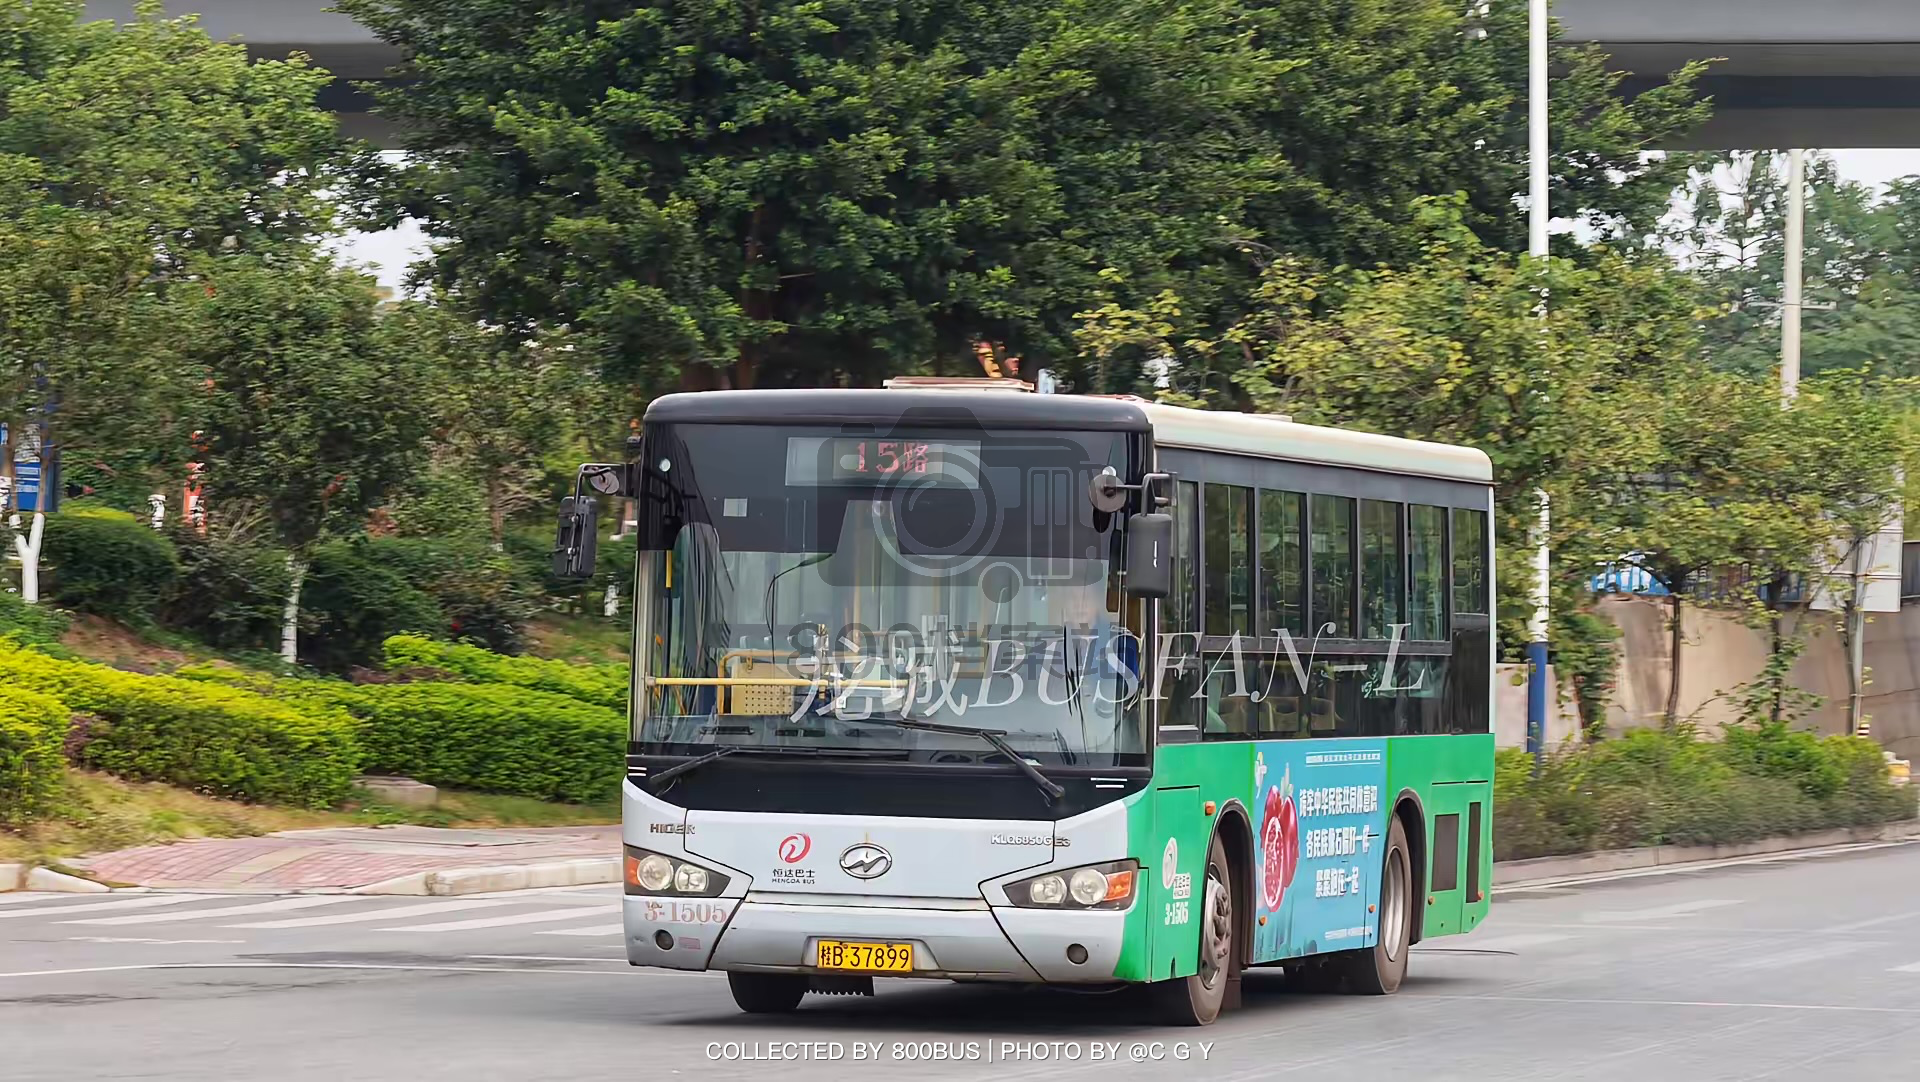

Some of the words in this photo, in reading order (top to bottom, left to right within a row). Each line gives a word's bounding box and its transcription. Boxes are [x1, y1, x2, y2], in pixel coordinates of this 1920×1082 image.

[856, 441, 928, 473] 15路
[772, 868, 816, 878] 恒达巴士
